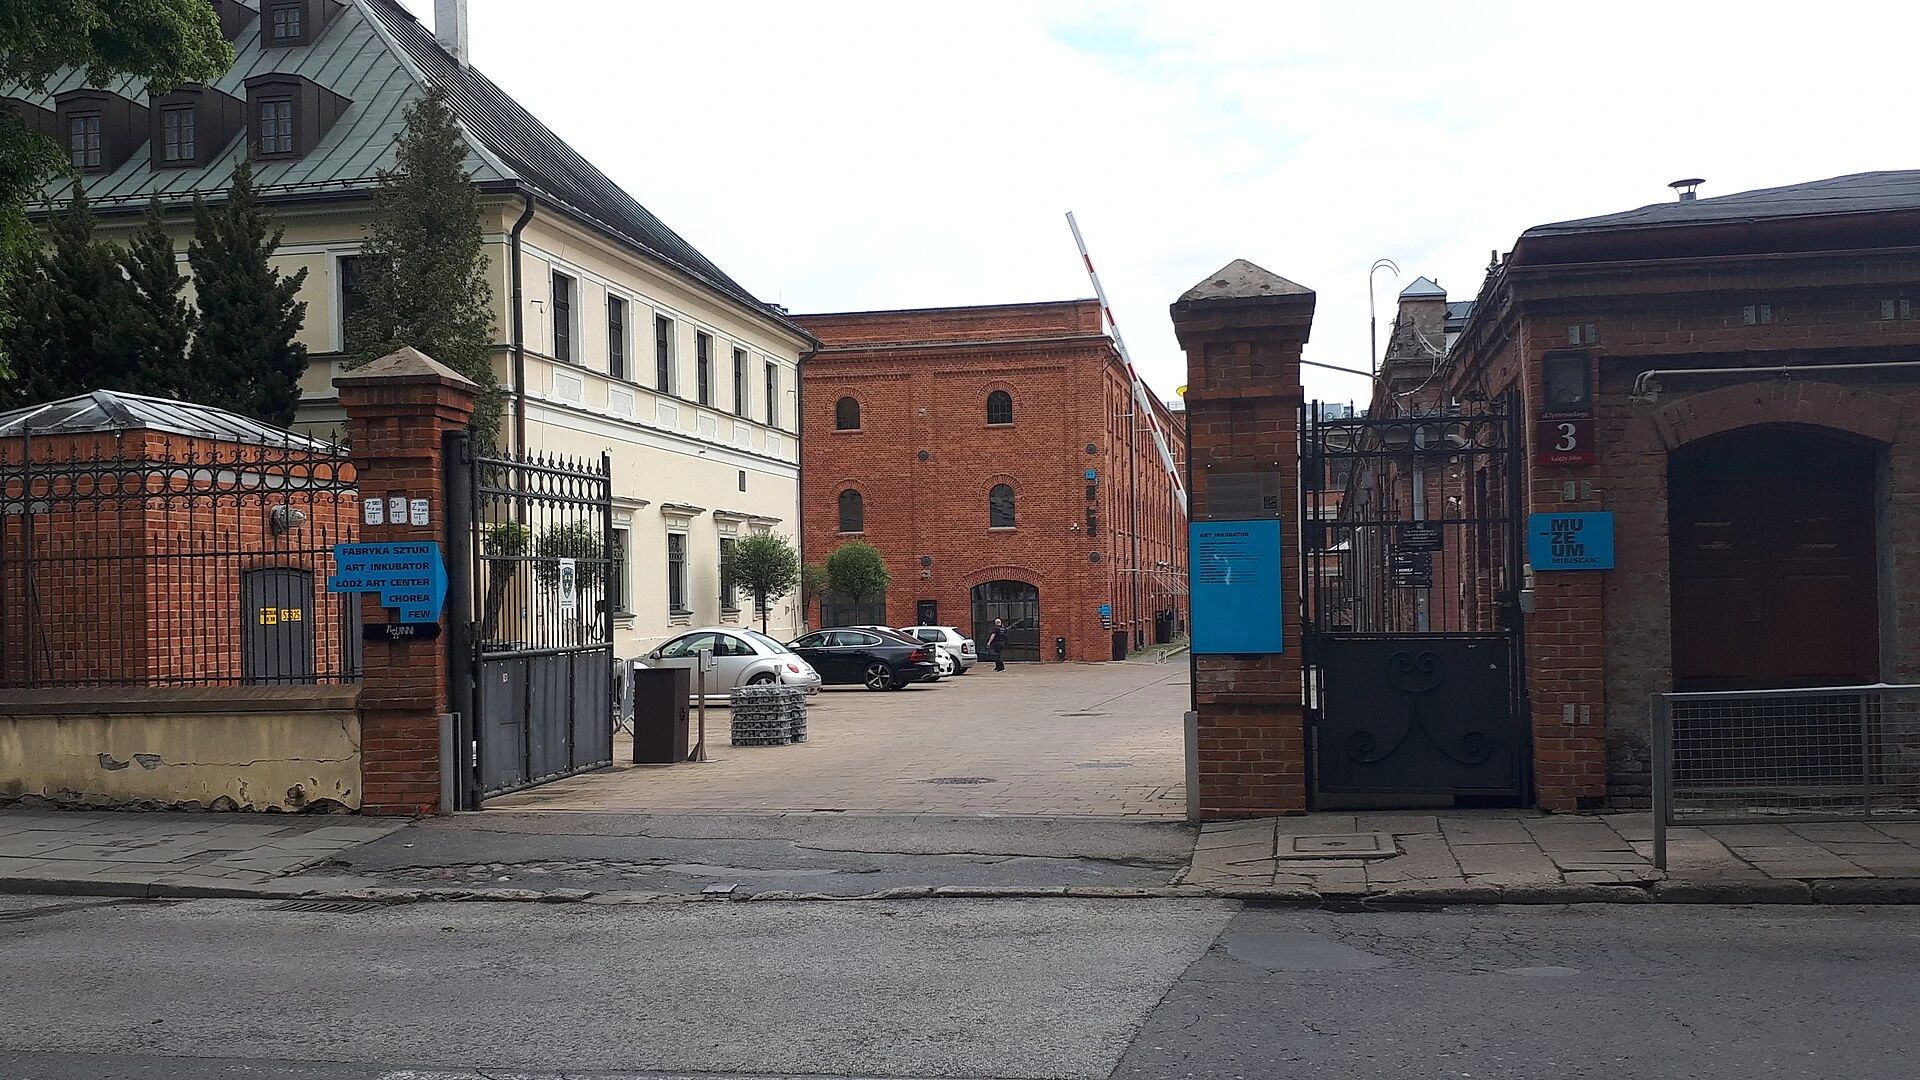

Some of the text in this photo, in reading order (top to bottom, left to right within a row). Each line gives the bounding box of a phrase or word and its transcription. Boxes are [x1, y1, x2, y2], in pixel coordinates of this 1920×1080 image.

[1555, 423, 1576, 451] 3
[1551, 518, 1584, 532] MU
[1551, 531, 1576, 544] ZE
[342, 546, 430, 556] FABRYKA SZTUKI
[1551, 543, 1585, 557] UM
[345, 562, 430, 573] ART_INKUBATOR
[336, 577, 430, 588] ŁÓDŹ ART CENTER
[389, 594, 430, 603] CHOREA
[407, 610, 431, 619] FEW
